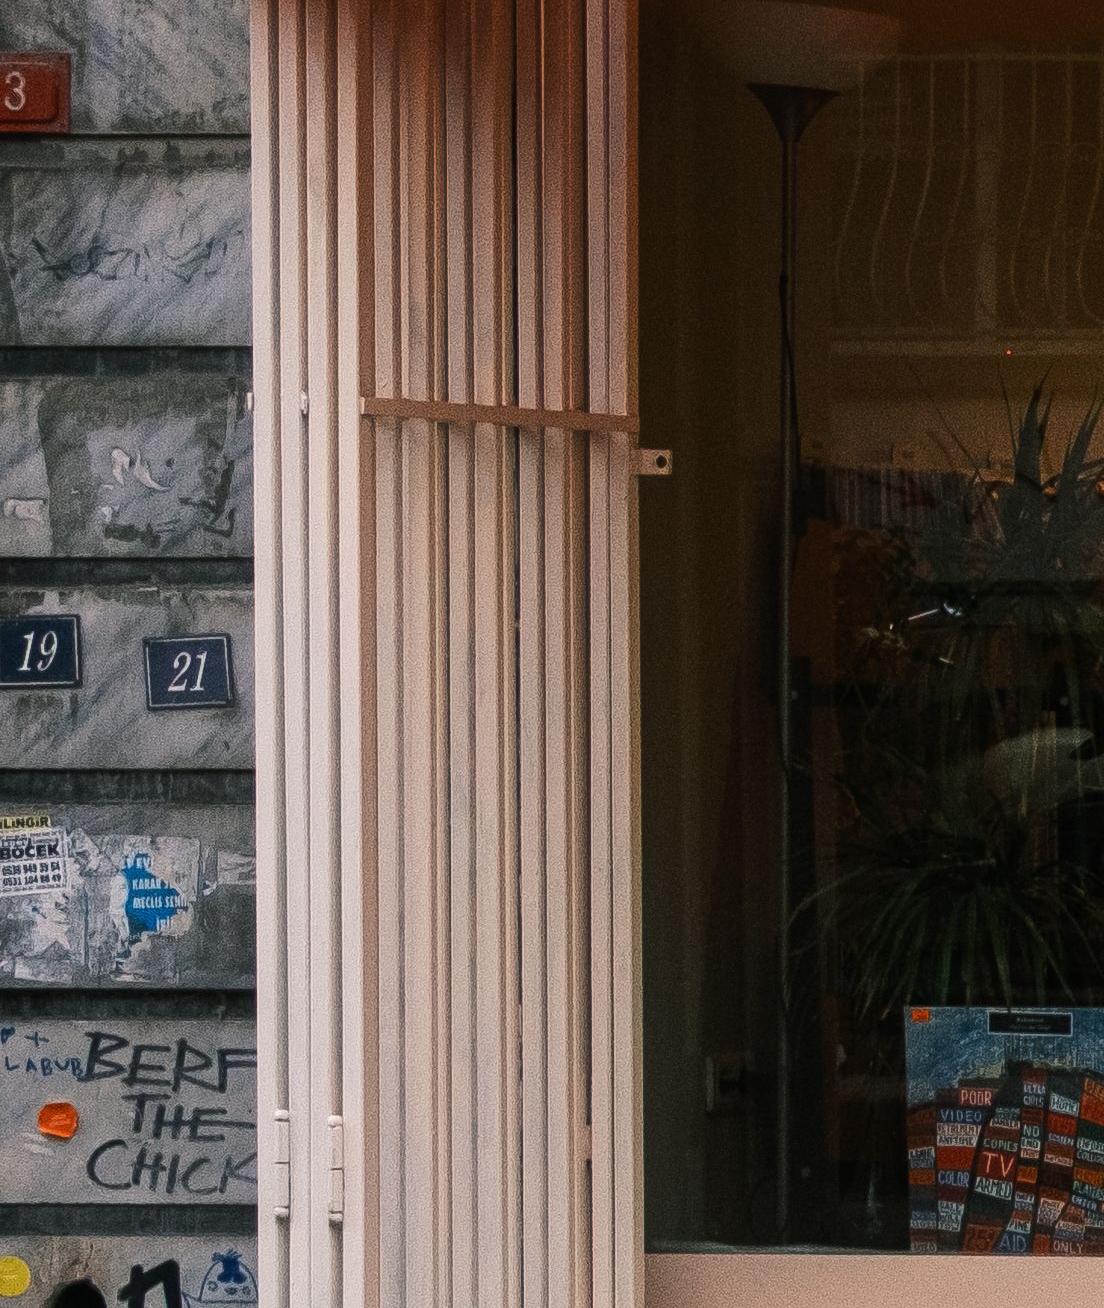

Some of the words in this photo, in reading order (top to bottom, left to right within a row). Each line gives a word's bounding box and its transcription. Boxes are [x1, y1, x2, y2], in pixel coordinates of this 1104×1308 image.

[18, 630, 58, 672] 19
[167, 650, 208, 692] 21
[960, 1089, 993, 1106] POOR
[122, 1093, 252, 1141] THE
[941, 1108, 983, 1123] VIDEO
[1023, 1124, 1040, 1138] NO
[983, 1137, 1018, 1152] COPIES
[86, 1138, 257, 1193] CHICK
[982, 1151, 1015, 1178] TV
[938, 1170, 971, 1188] COLOR
[997, 1232, 1029, 1254] AID
[1053, 1241, 1084, 1254] ONLY
